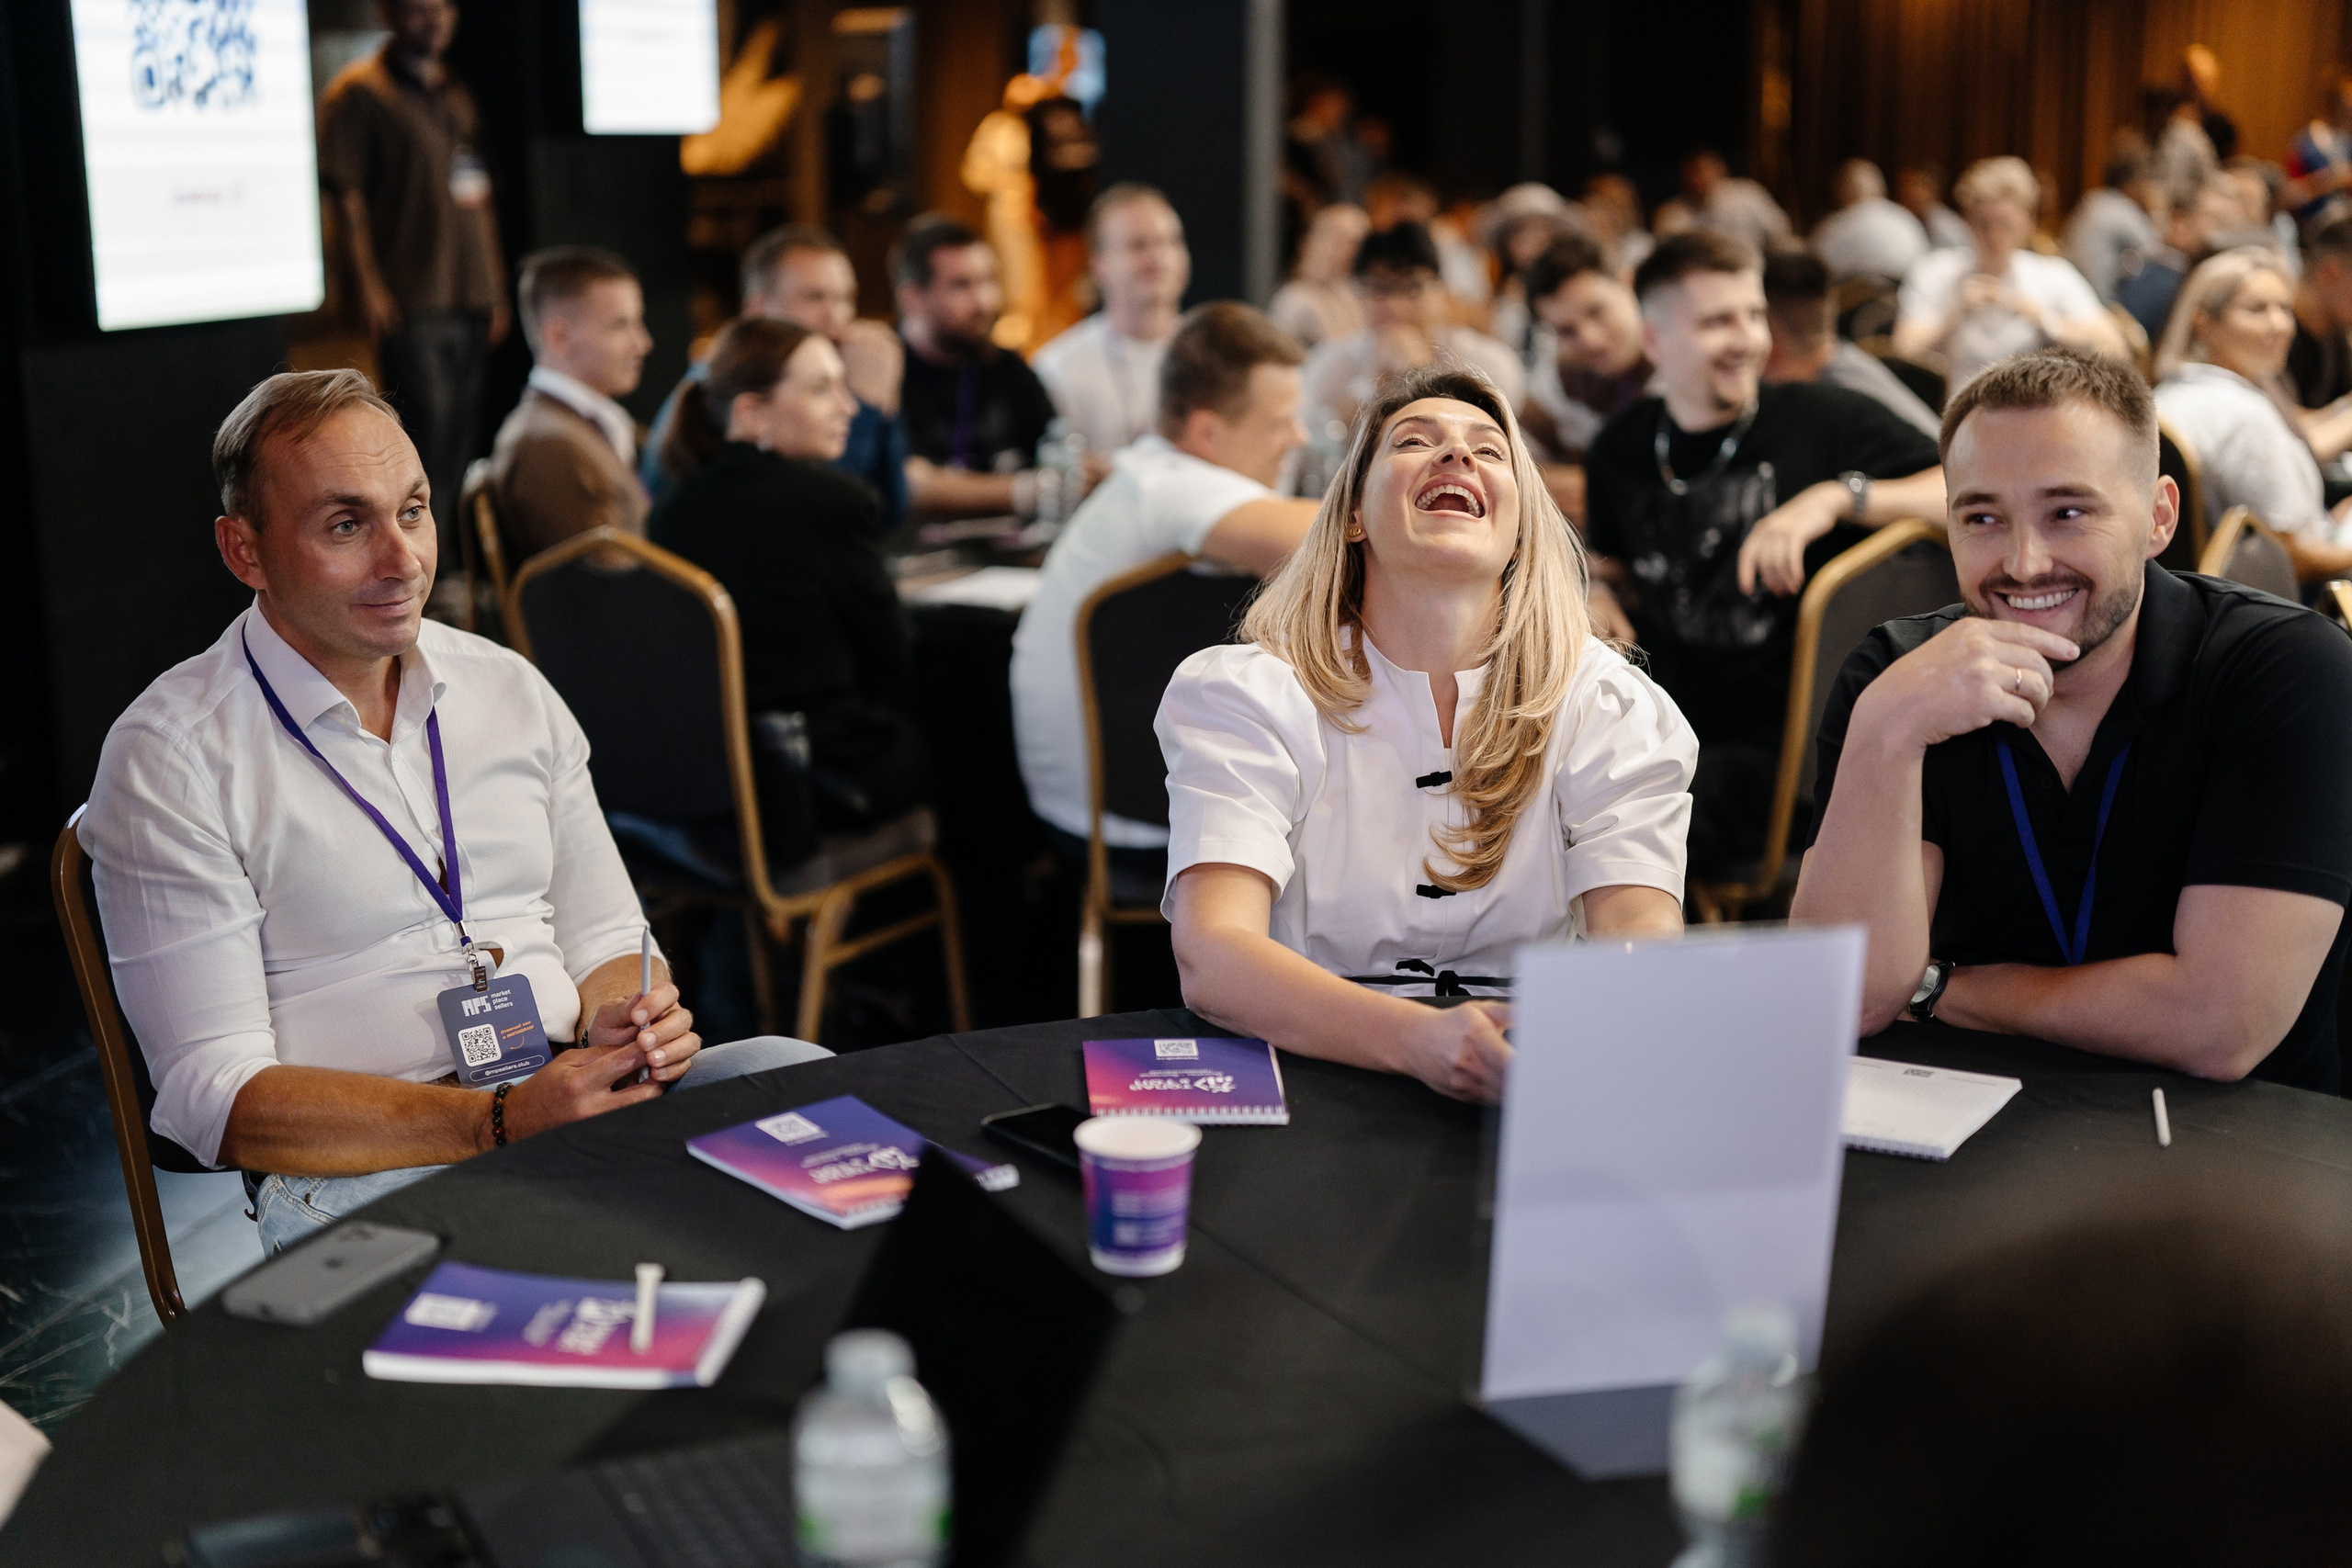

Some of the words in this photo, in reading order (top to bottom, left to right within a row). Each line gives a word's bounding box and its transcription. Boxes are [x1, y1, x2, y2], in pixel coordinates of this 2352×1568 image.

[491, 989, 512, 998] market
[492, 996, 508, 1005] place
[461, 995, 492, 1017] MPS
[494, 1001, 514, 1010] sellers
[484, 1060, 530, 1077] @mpsellers.club
